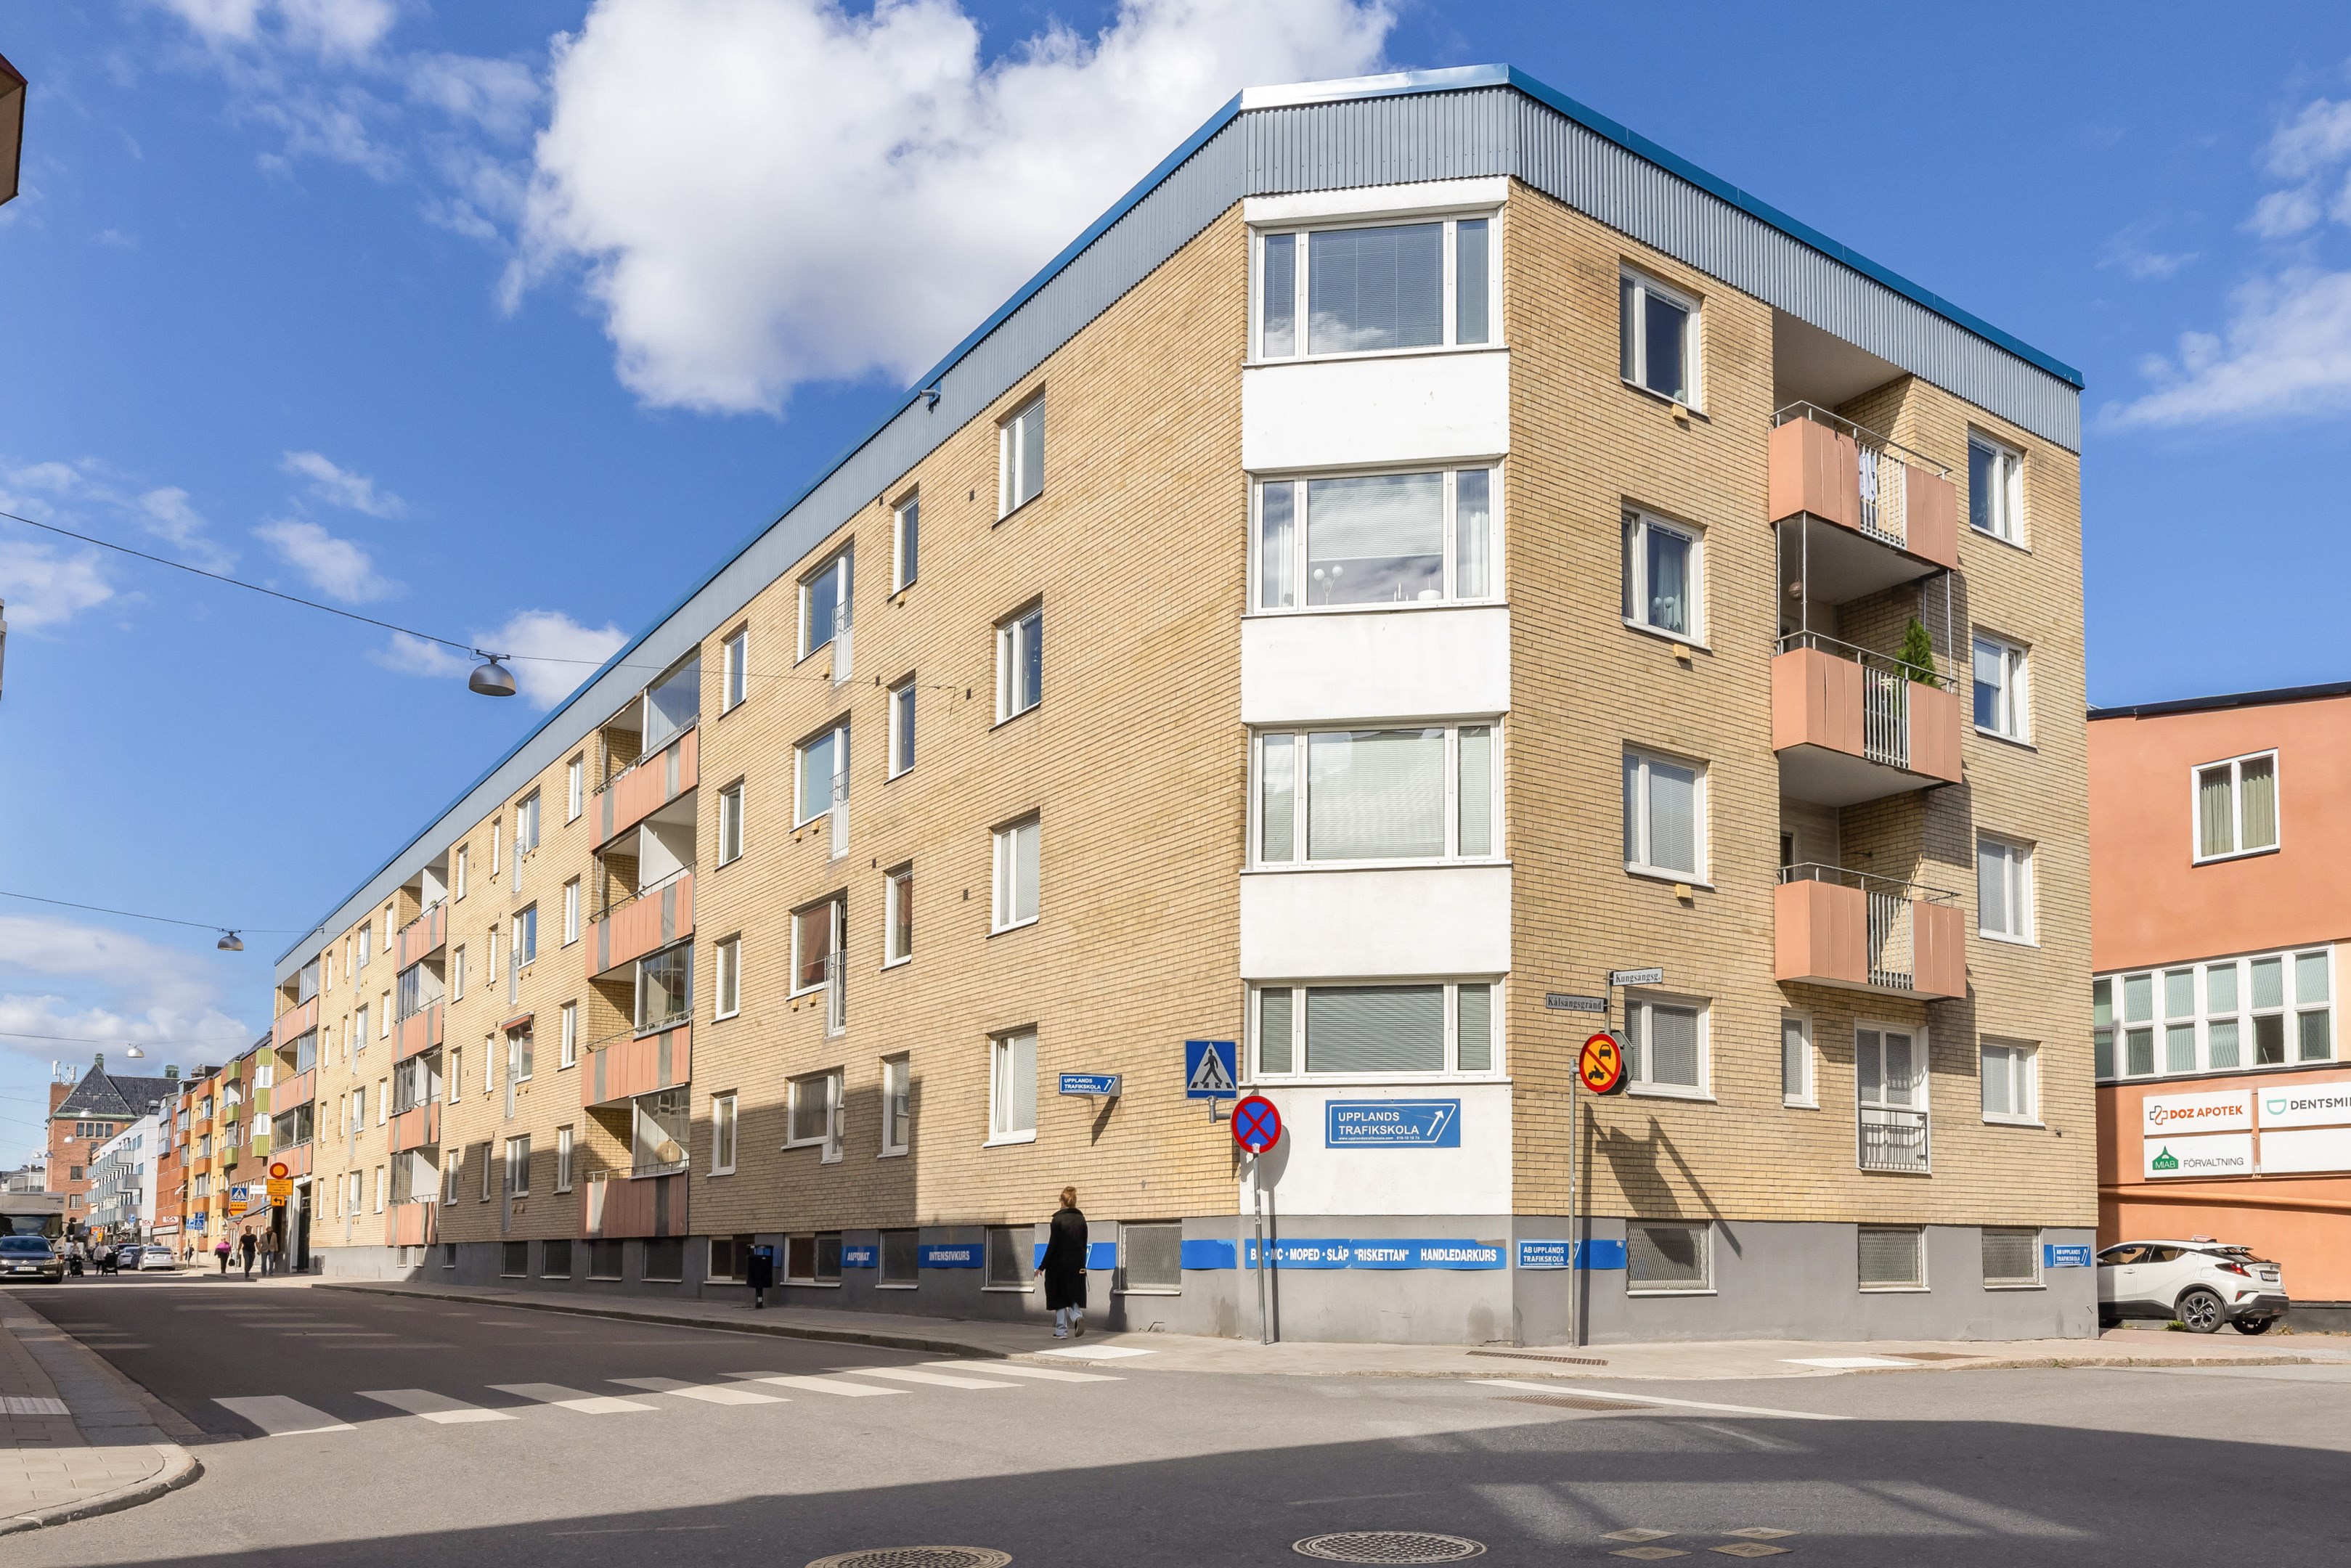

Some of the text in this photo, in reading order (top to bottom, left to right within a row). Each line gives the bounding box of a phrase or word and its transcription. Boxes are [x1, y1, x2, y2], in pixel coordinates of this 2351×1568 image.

[1615, 972, 1661, 983] Kungsängsg.
[1547, 996, 1602, 1010] Kålsängsgränd
[1338, 1112, 1400, 1122] UPPLANDS
[2169, 1105, 2244, 1119] DOZ APOTEK
[1338, 1125, 1419, 1135] TRAFIKSKOLA
[2183, 1157, 2244, 1168] FÖRVALTNING
[929, 1251, 970, 1261] INTENSIVKURS
[1289, 1248, 1320, 1261] MOPED
[1327, 1246, 1349, 1261] SLÄP
[1420, 1248, 1497, 1262] HANDLEDARKURS
